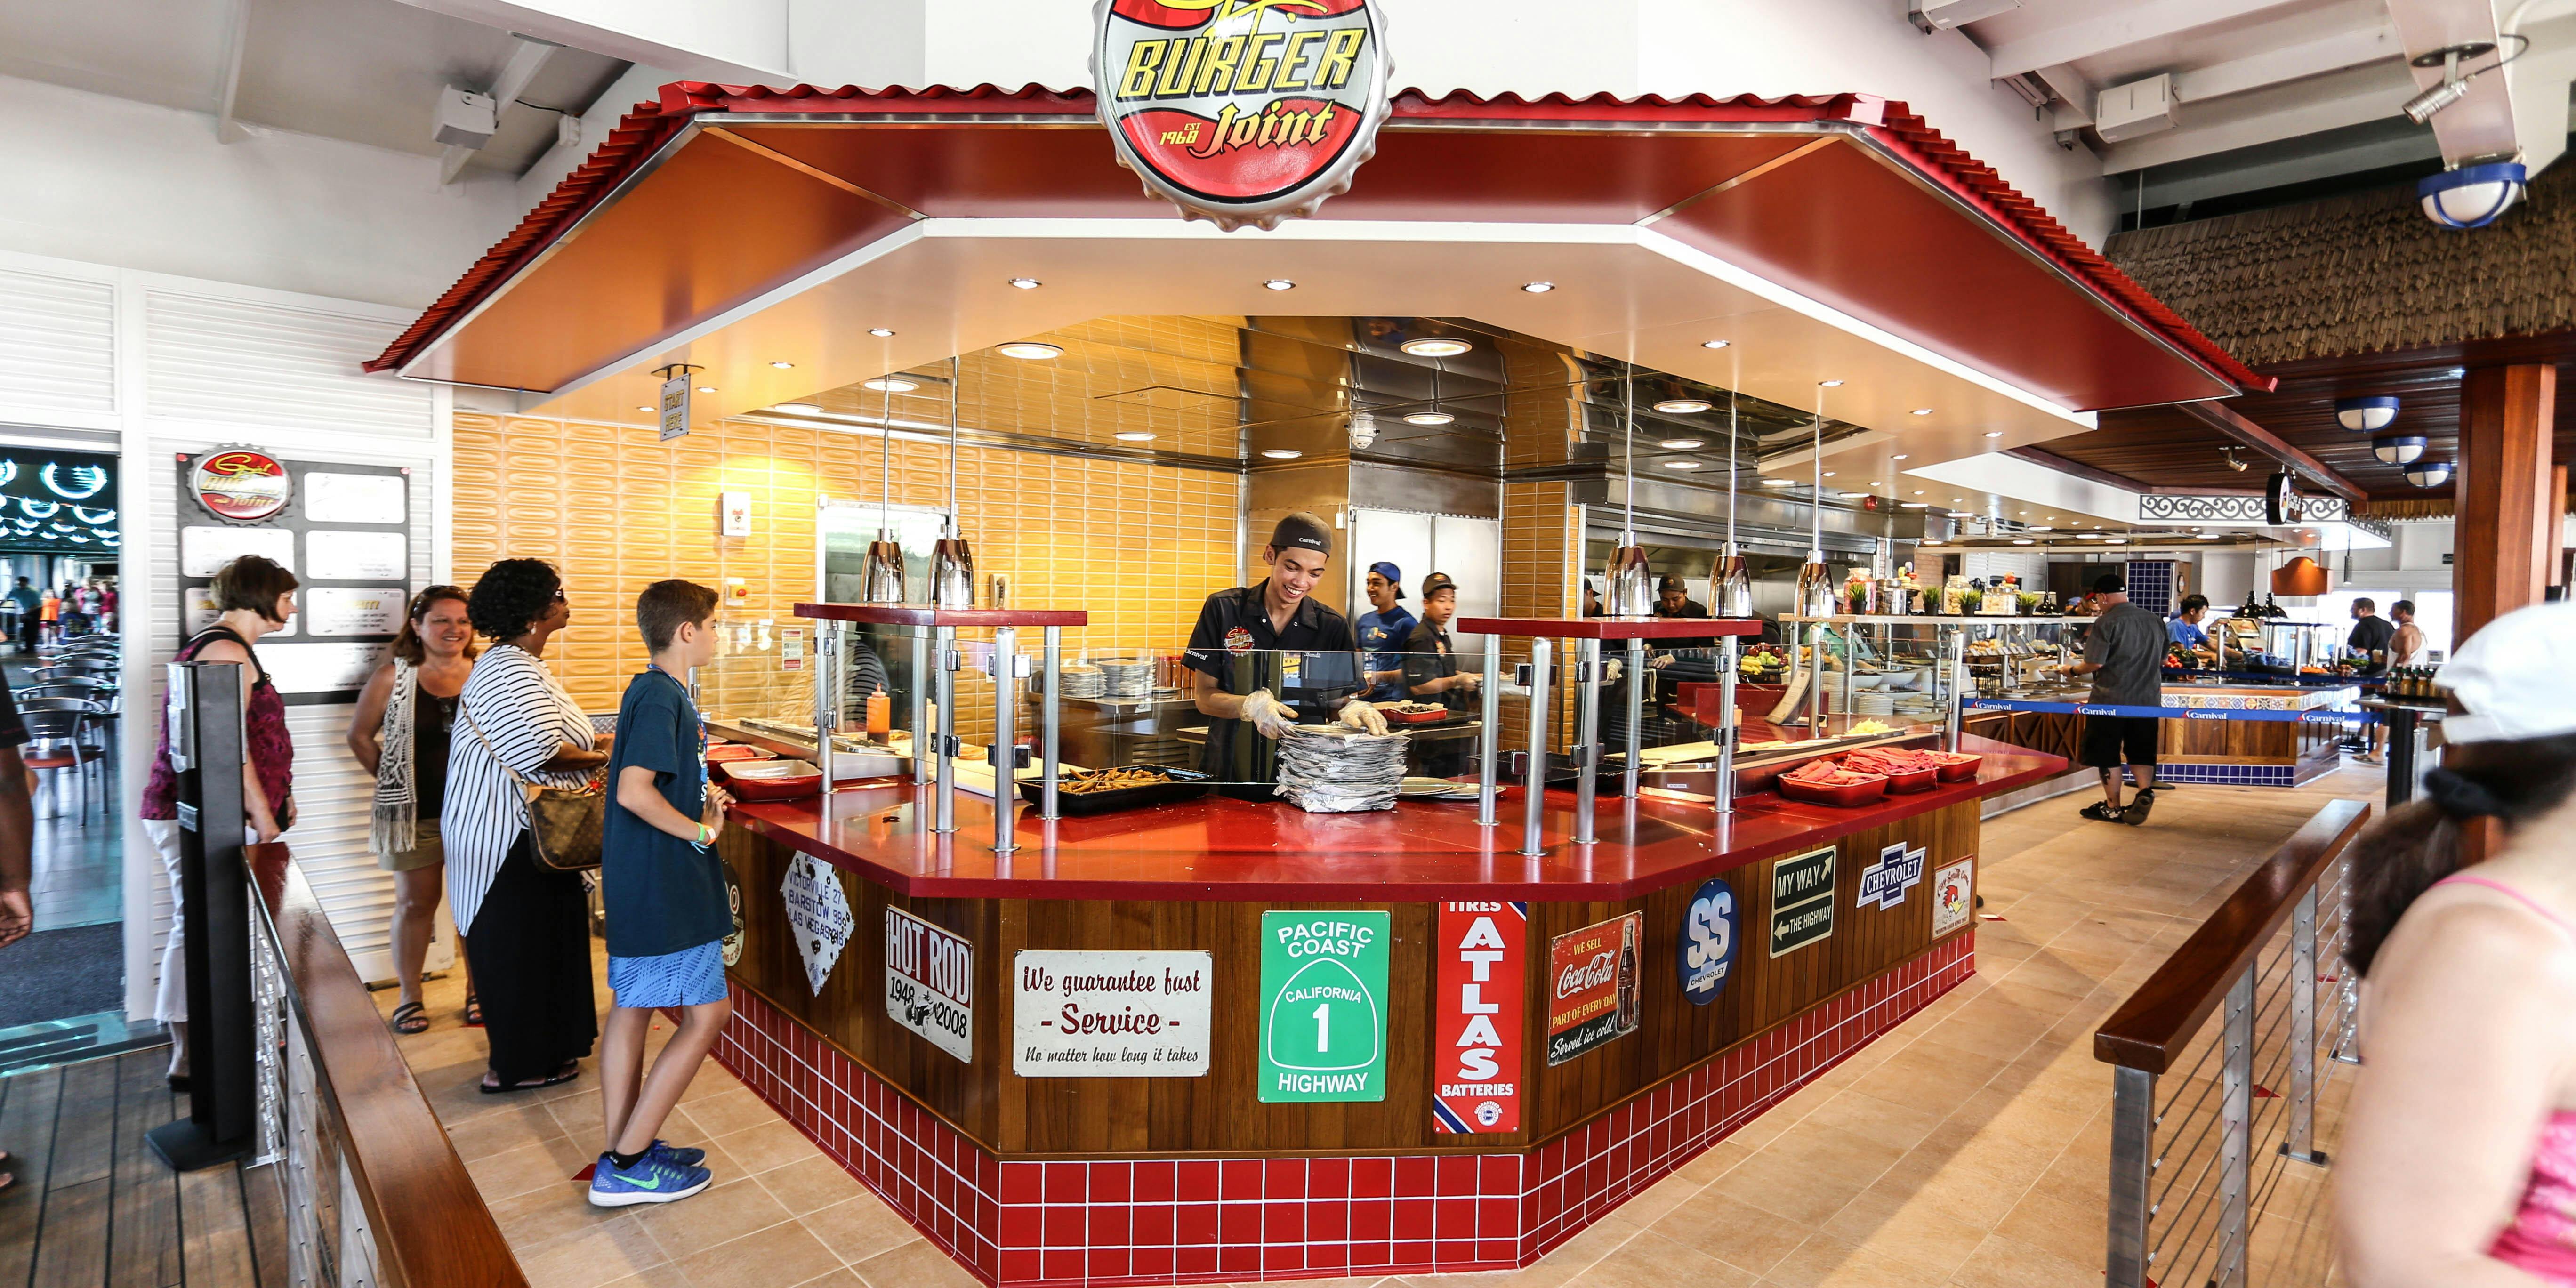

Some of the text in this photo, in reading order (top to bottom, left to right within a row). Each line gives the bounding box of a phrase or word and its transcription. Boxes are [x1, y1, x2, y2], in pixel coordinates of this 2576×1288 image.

[1116, 28, 1367, 102] BURGER
[1160, 130, 1199, 145] 1968
[1187, 100, 1336, 158] Joint
[664, 389, 684, 411] START
[666, 411, 682, 432] HERE
[1298, 538, 1321, 546] Carnival
[1978, 702, 2012, 711] Carnival
[2081, 706, 2116, 716] Carnival
[2190, 711, 2227, 720] Carnival
[2306, 714, 2346, 723] Carnival
[789, 870, 841, 904] VICTORVILLE 27
[1777, 864, 1821, 898] MY WAY
[1866, 859, 1919, 893] CHEVROLET
[789, 889, 829, 920] BARSTOW
[1447, 902, 1502, 912] TIRES
[789, 907, 802, 926] LAS
[805, 916, 830, 940] VEGAS
[1687, 891, 1731, 968] SS
[1789, 904, 1832, 934] THE HIGHWAY
[1277, 921, 1374, 944] PACIFIC
[889, 912, 925, 980] HOT
[929, 933, 970, 1005] ROD
[1288, 939, 1365, 958] COAST
[1573, 937, 1602, 956] WE SELL
[1023, 966, 1201, 998] We guarantee fast
[1557, 949, 1616, 999] Coca-Cola
[1691, 967, 1724, 986] CHEVROLET
[890, 976, 967, 1039] 1948 2008
[1285, 986, 1361, 1003] CALIFORNIA
[1456, 916, 1506, 1080] ATLAS
[1061, 1003, 1161, 1035] Service
[1553, 1011, 1570, 1029] PART
[1572, 1007, 1581, 1021] OF
[1582, 999, 1603, 1016] EVERY
[1604, 993, 1617, 1006] DAY
[1312, 1003, 1329, 1053] 1
[1551, 1015, 1615, 1058] Served ice cold
[1025, 1046, 1198, 1065] No matter how long it takes
[1278, 1072, 1368, 1093] HIGHWAY
[1441, 1083, 1514, 1097] BATTERIES
[1474, 1101, 1500, 1114] GUARANTEED
